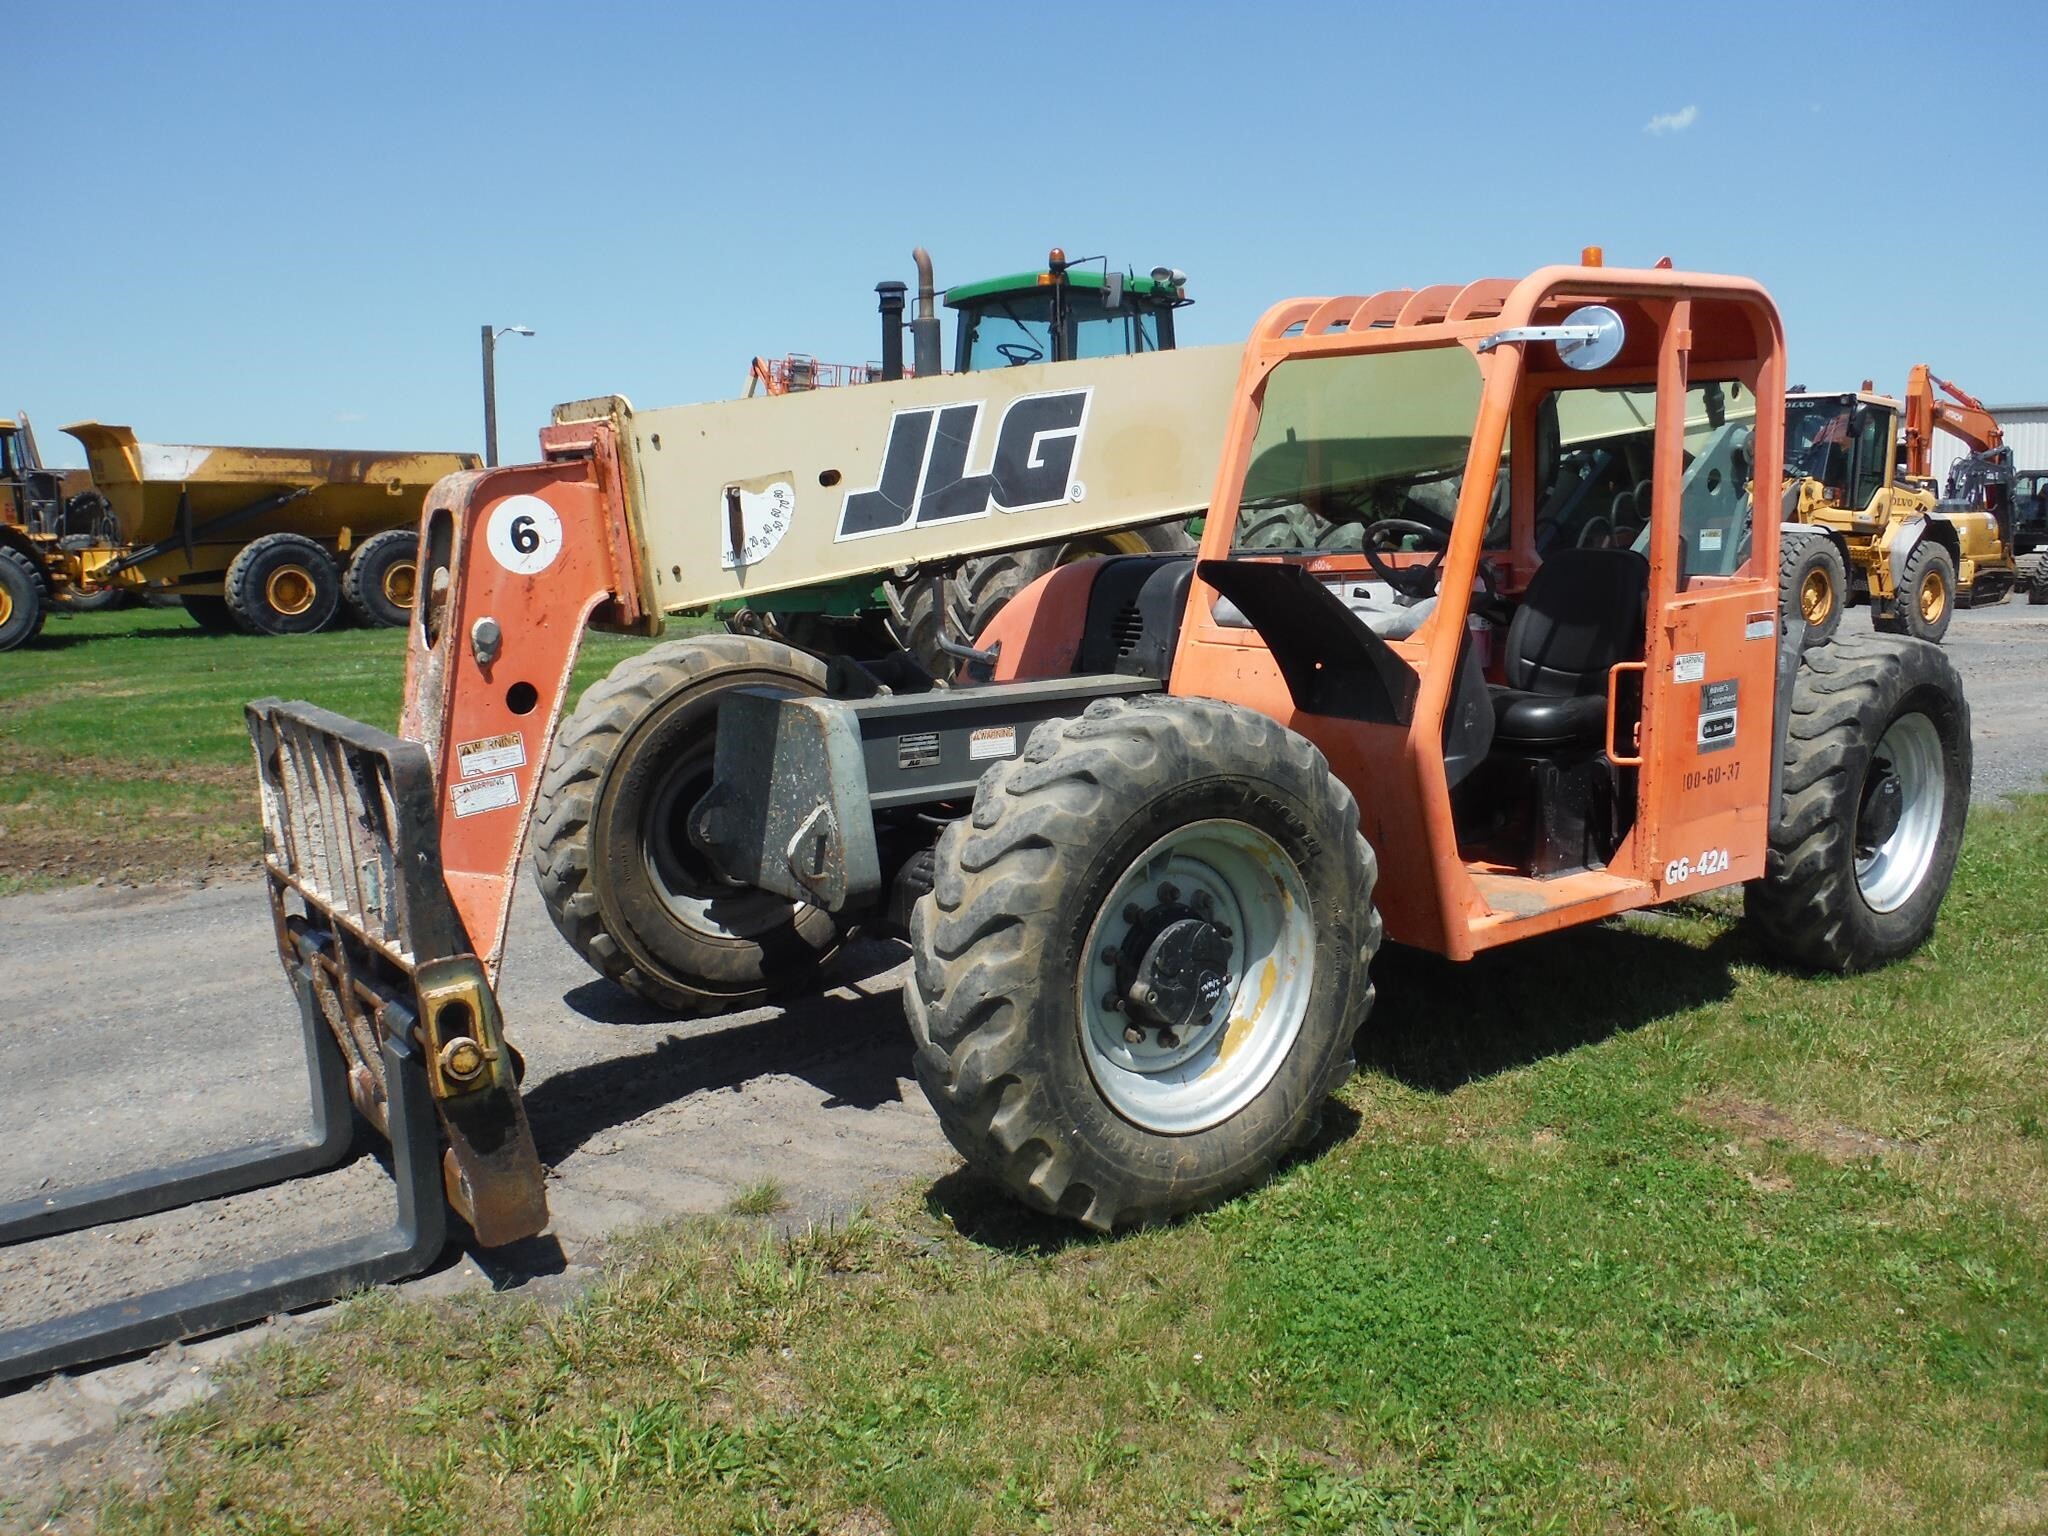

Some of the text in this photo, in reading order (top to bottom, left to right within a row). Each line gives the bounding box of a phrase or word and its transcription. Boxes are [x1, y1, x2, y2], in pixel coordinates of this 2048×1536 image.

[836, 388, 1092, 541] JLG
[1891, 496, 1913, 507] OLVO
[510, 515, 540, 554] 6
[472, 735, 520, 752] WRNING
[1682, 761, 1740, 792] 100-60-37
[1665, 848, 1729, 886] G6-42A
